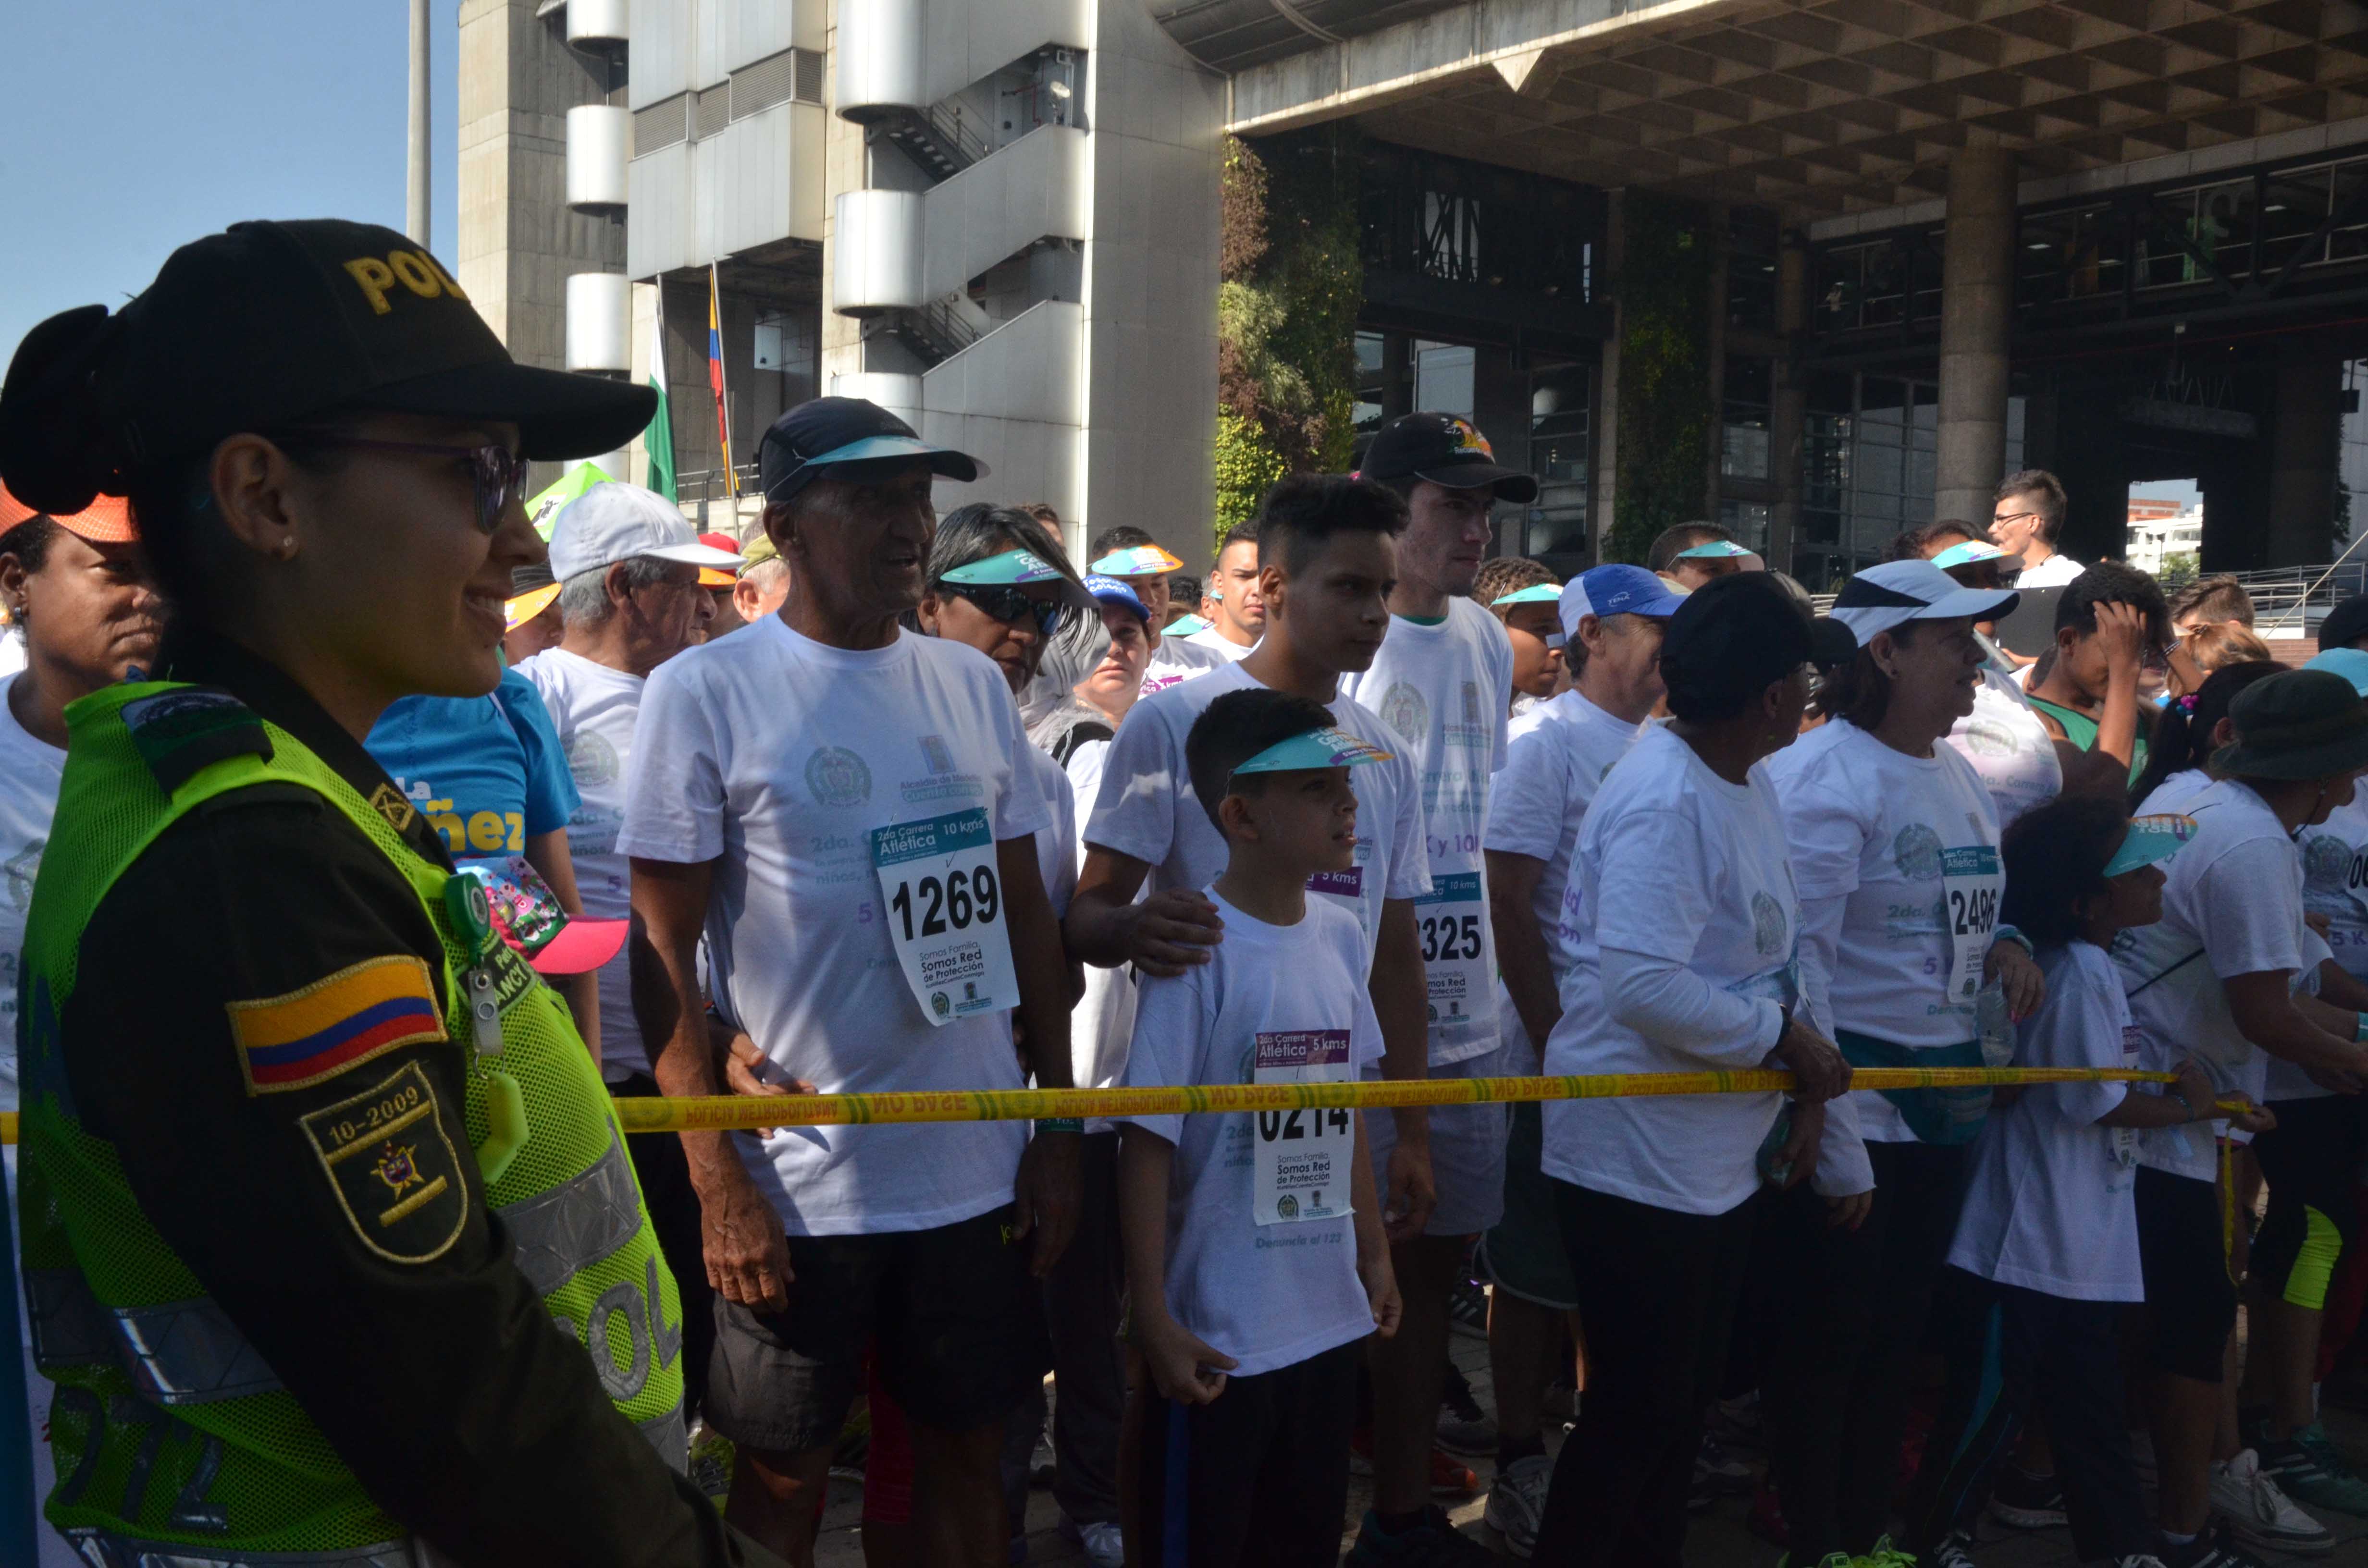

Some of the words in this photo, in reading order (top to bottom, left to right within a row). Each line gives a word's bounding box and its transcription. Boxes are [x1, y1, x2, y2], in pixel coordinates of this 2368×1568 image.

[395, 777, 432, 800] La
[898, 823, 934, 838] Carrera
[943, 824, 958, 836] 10
[960, 818, 985, 833] kms
[880, 833, 937, 857] Atlética
[607, 875, 622, 893] 5
[1332, 871, 1357, 884] kms
[1450, 881, 1458, 890] 10
[1460, 879, 1477, 889] kms
[892, 865, 998, 941] 1269
[1951, 888, 1996, 935] 2496
[858, 903, 872, 924] 5
[1416, 915, 1481, 962] 325
[2332, 931, 2345, 946] 5
[2352, 930, 2368, 945] K
[919, 948, 947, 962] Somos
[921, 957, 957, 973] Somos
[960, 949, 982, 963] Red
[923, 970, 935, 982] de
[936, 961, 985, 979] Protección
[1923, 956, 1937, 975] 5
[493, 962, 528, 1006] ANCY
[1428, 980, 1446, 990] mos
[1448, 977, 1466, 988] Red
[1275, 1033, 1306, 1043] Carrera
[1313, 1038, 1320, 1051] 5
[1322, 1038, 1347, 1051] kms
[1258, 1042, 1307, 1058] Atlética
[329, 1086, 419, 1145] 10-2009
[1278, 1165, 1310, 1175] Somos
[1313, 1161, 1331, 1172] Red
[1277, 1175, 1288, 1184] de
[1290, 1172, 1330, 1183] Protección
[1255, 1237, 1307, 1249] Denuncia
[1311, 1234, 1321, 1245] al
[552, 1253, 684, 1402] OL
